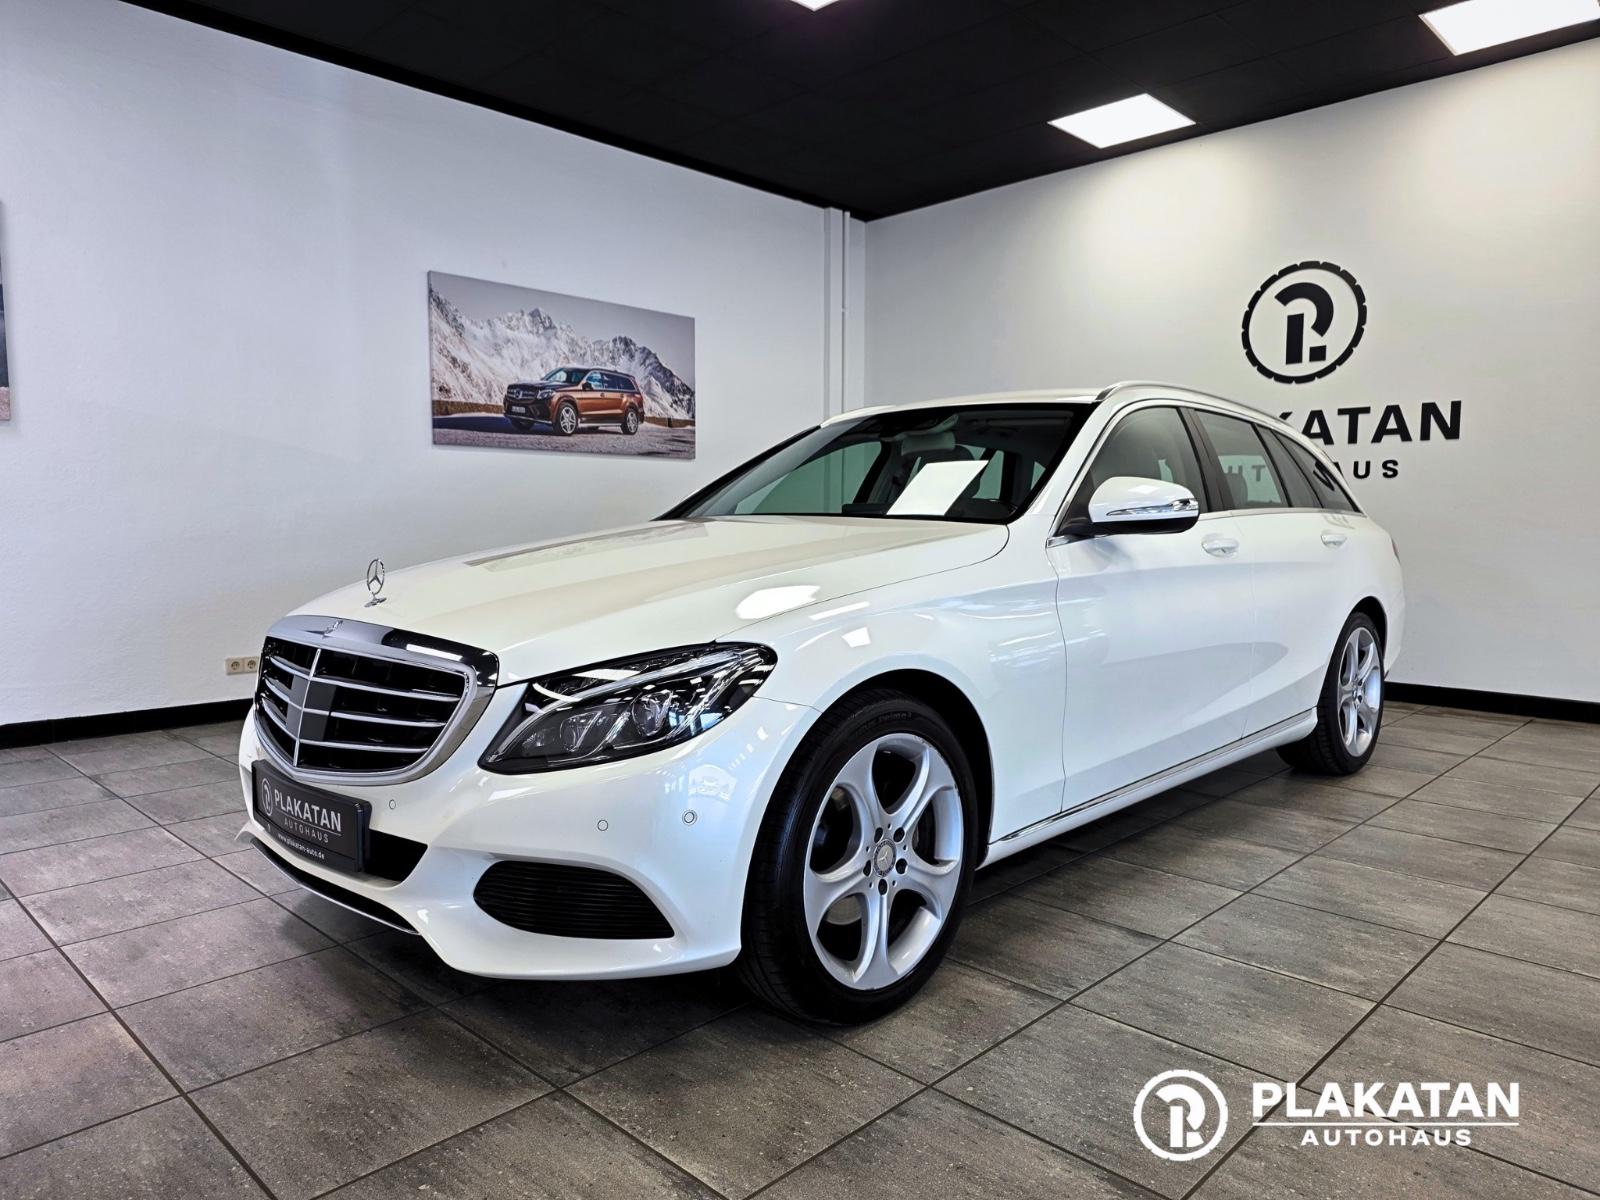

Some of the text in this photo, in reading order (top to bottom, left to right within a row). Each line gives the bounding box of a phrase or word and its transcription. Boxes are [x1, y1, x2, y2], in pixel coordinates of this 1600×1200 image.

[1279, 400, 1462, 446] ATAN
[273, 788, 342, 832] PLAKATAN
[284, 818, 329, 844] AUTOHAUS
